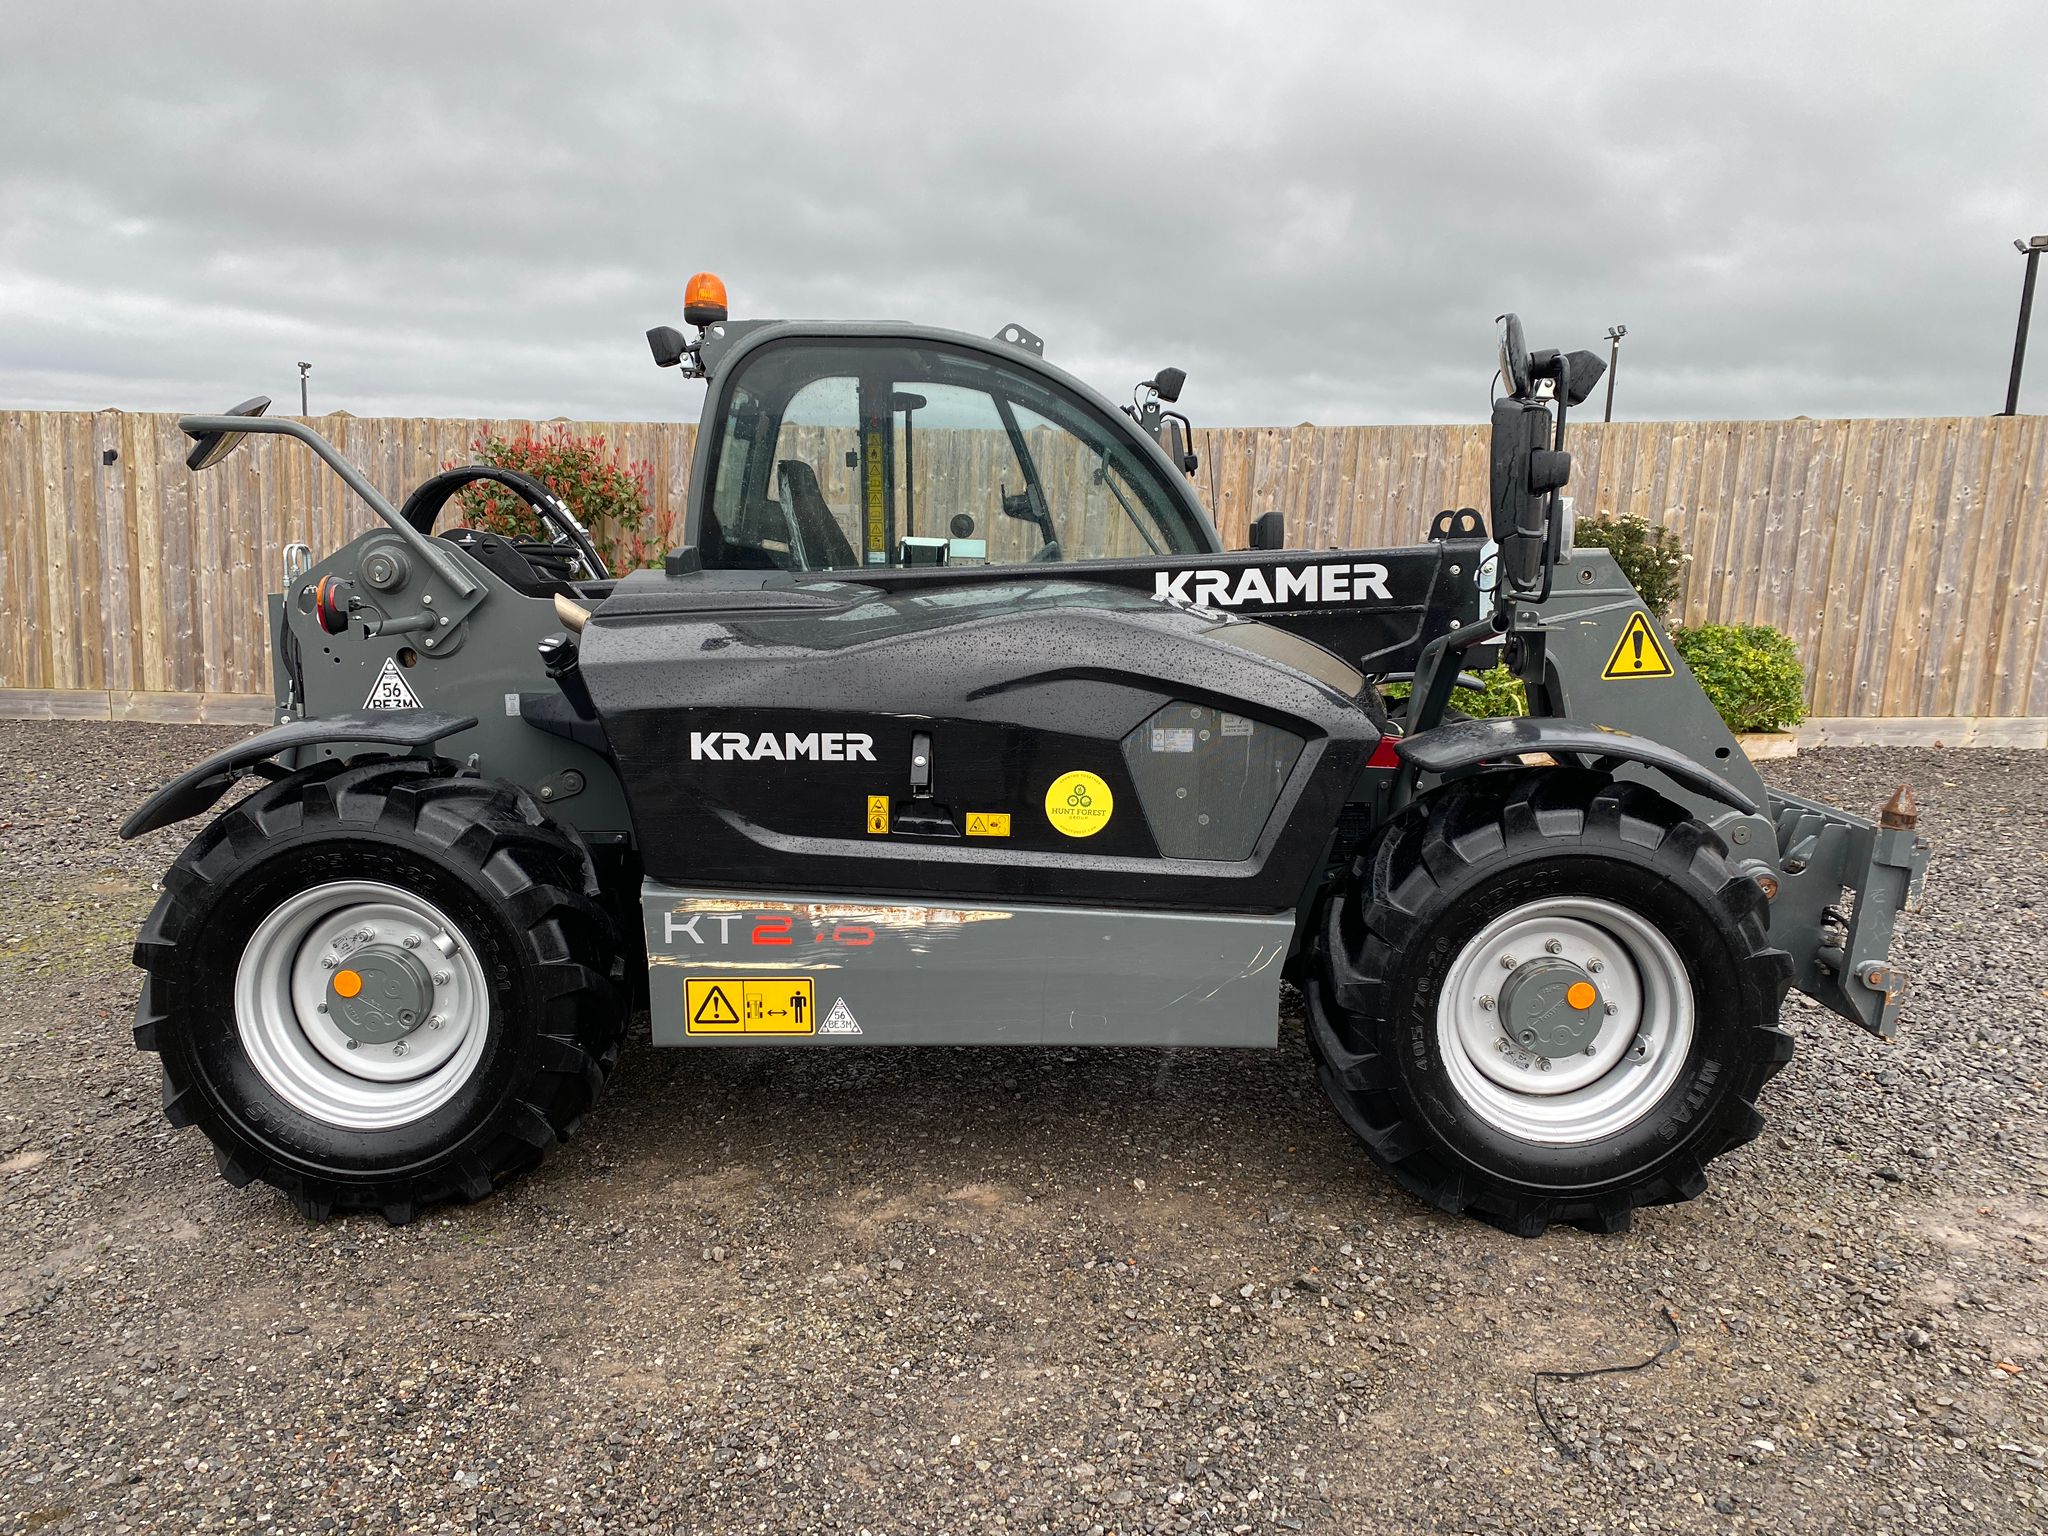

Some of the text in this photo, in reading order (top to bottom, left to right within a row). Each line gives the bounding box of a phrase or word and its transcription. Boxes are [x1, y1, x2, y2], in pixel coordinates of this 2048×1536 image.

[1155, 563, 1393, 606] KRAMER
[383, 682, 402, 698] 56
[690, 732, 878, 761] KRAMER
[1051, 807, 1107, 817] HUNT FOREST
[828, 1020, 852, 1029] BE3M
[834, 1011, 846, 1020] 56
[1658, 1058, 1722, 1141] MITAS
[244, 1100, 333, 1158] MITAS
